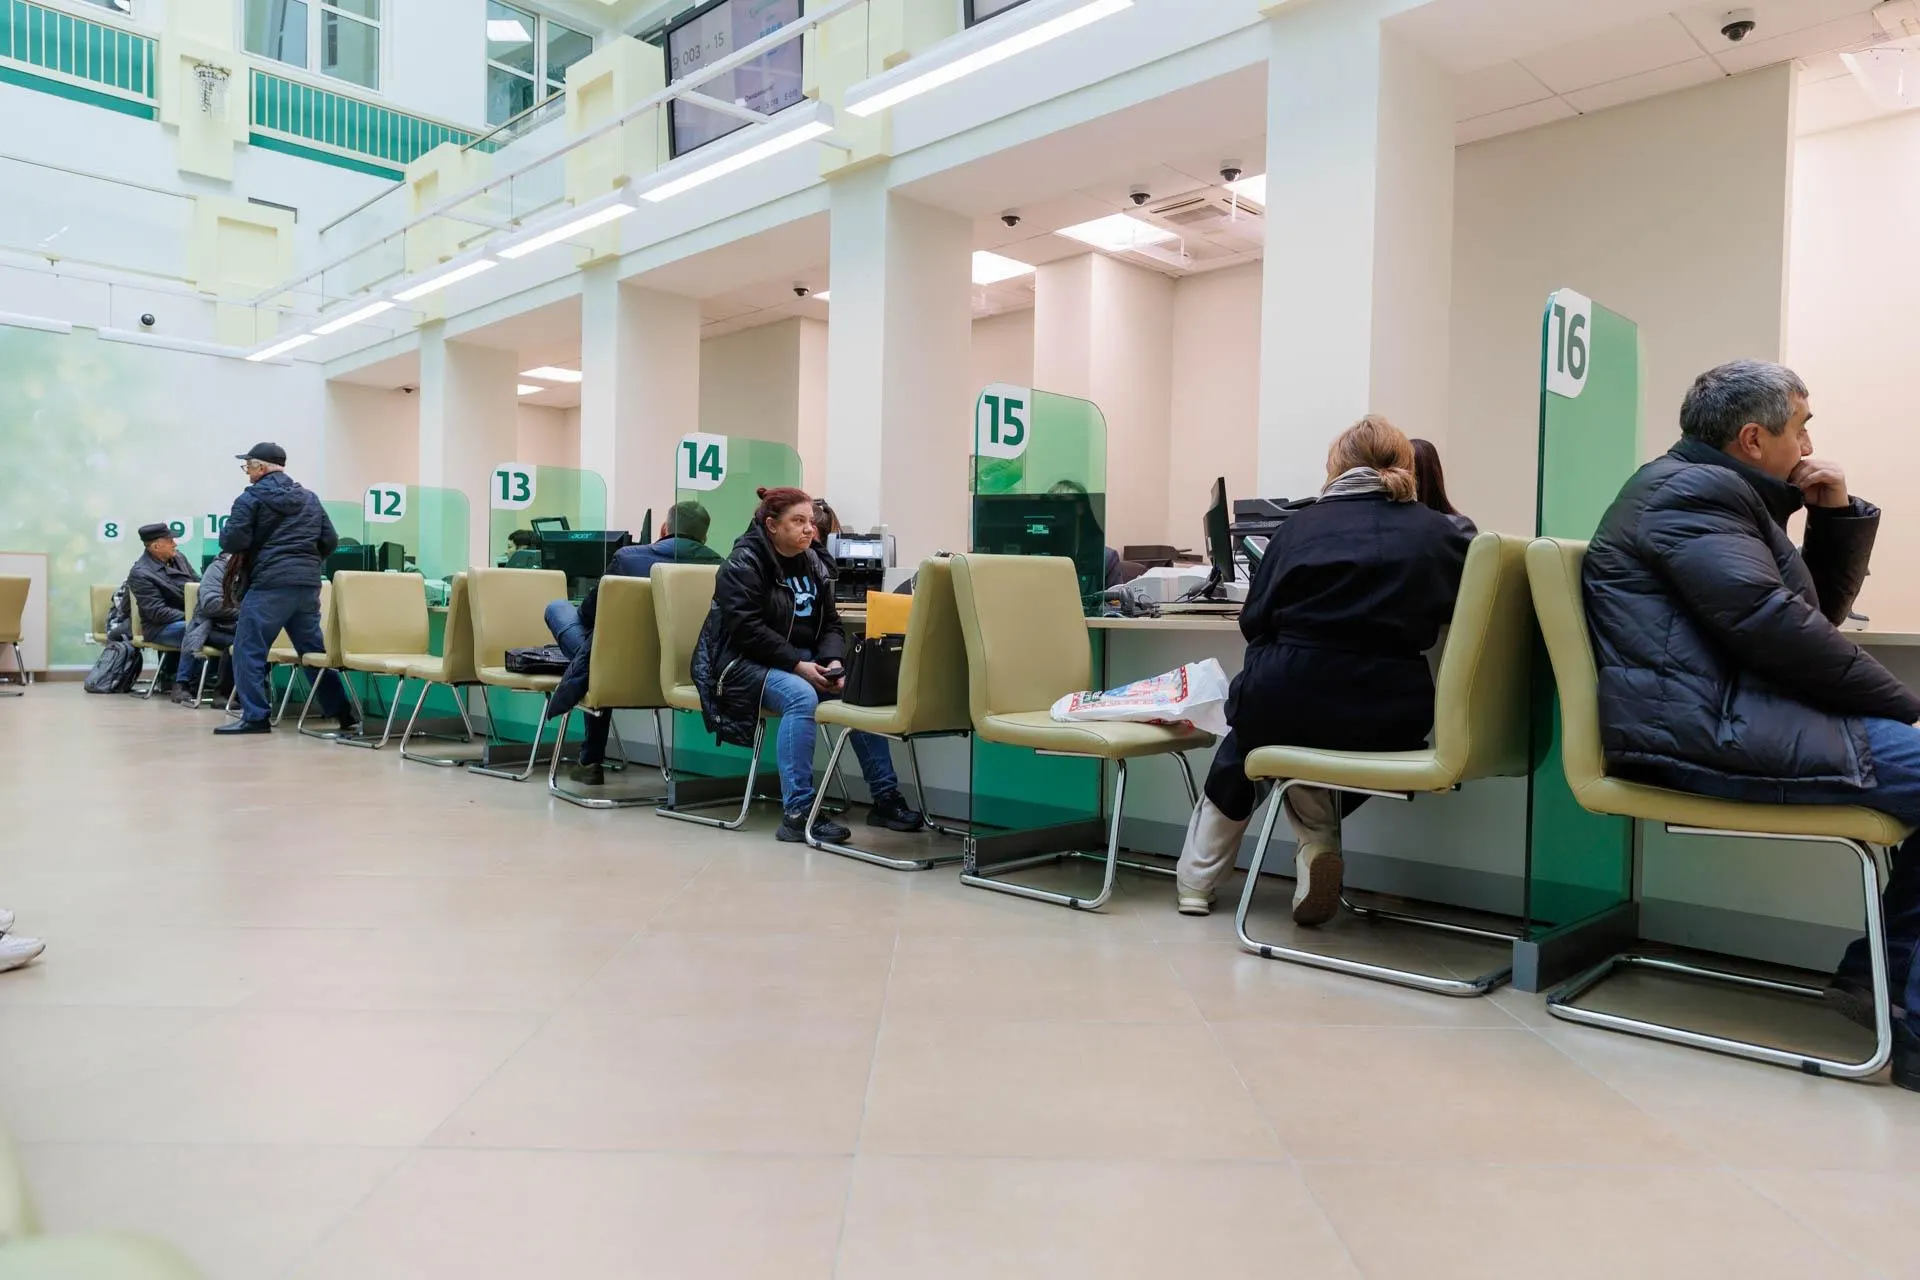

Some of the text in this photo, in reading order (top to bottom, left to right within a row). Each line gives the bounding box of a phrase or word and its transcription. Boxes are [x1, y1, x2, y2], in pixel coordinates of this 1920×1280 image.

[683, 44, 700, 65] 003
[713, 31, 725, 49] 15
[1554, 303, 1586, 380] 16
[984, 394, 1025, 446] 15
[683, 441, 723, 481] 14
[496, 470, 531, 502] 13
[369, 489, 402, 517] 12
[104, 522, 118, 538] 8
[169, 521, 186, 538] 9
